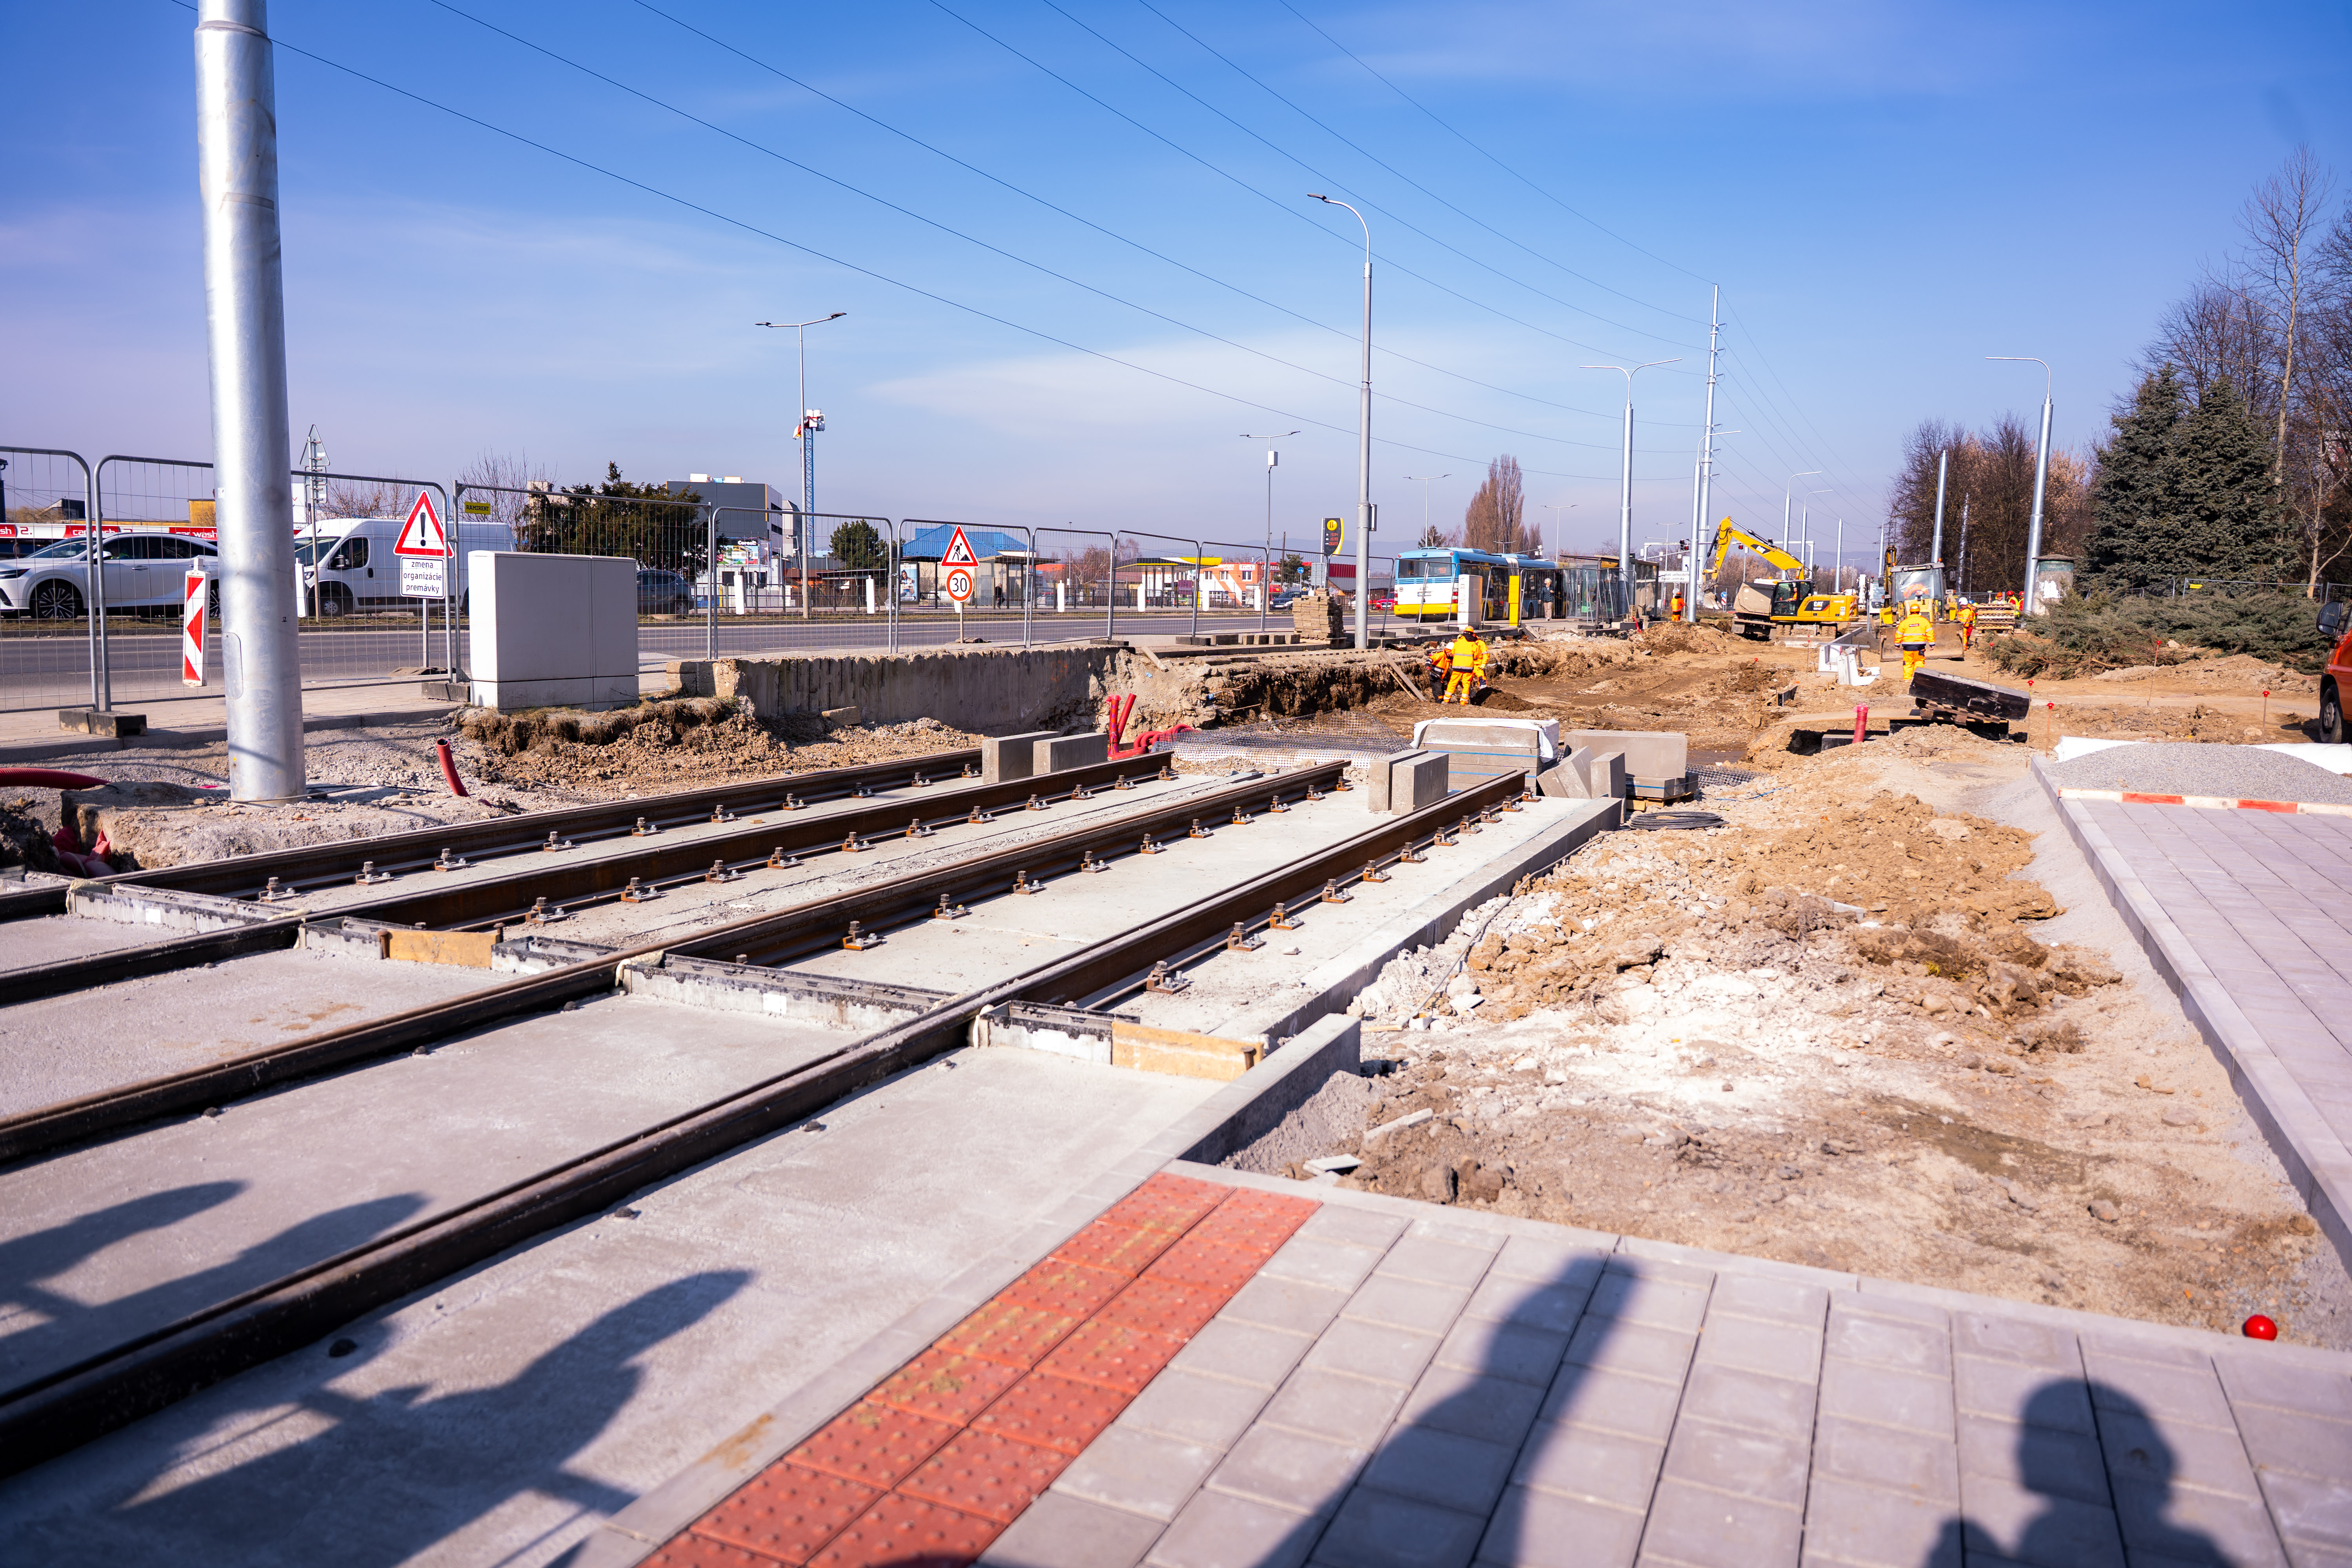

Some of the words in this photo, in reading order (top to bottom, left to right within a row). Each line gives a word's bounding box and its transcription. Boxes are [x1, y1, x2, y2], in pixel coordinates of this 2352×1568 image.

[1756, 545, 1766, 554] CAT
[403, 572, 442, 581] organizácie
[406, 584, 439, 594] premávky
[952, 577, 967, 592] 30
